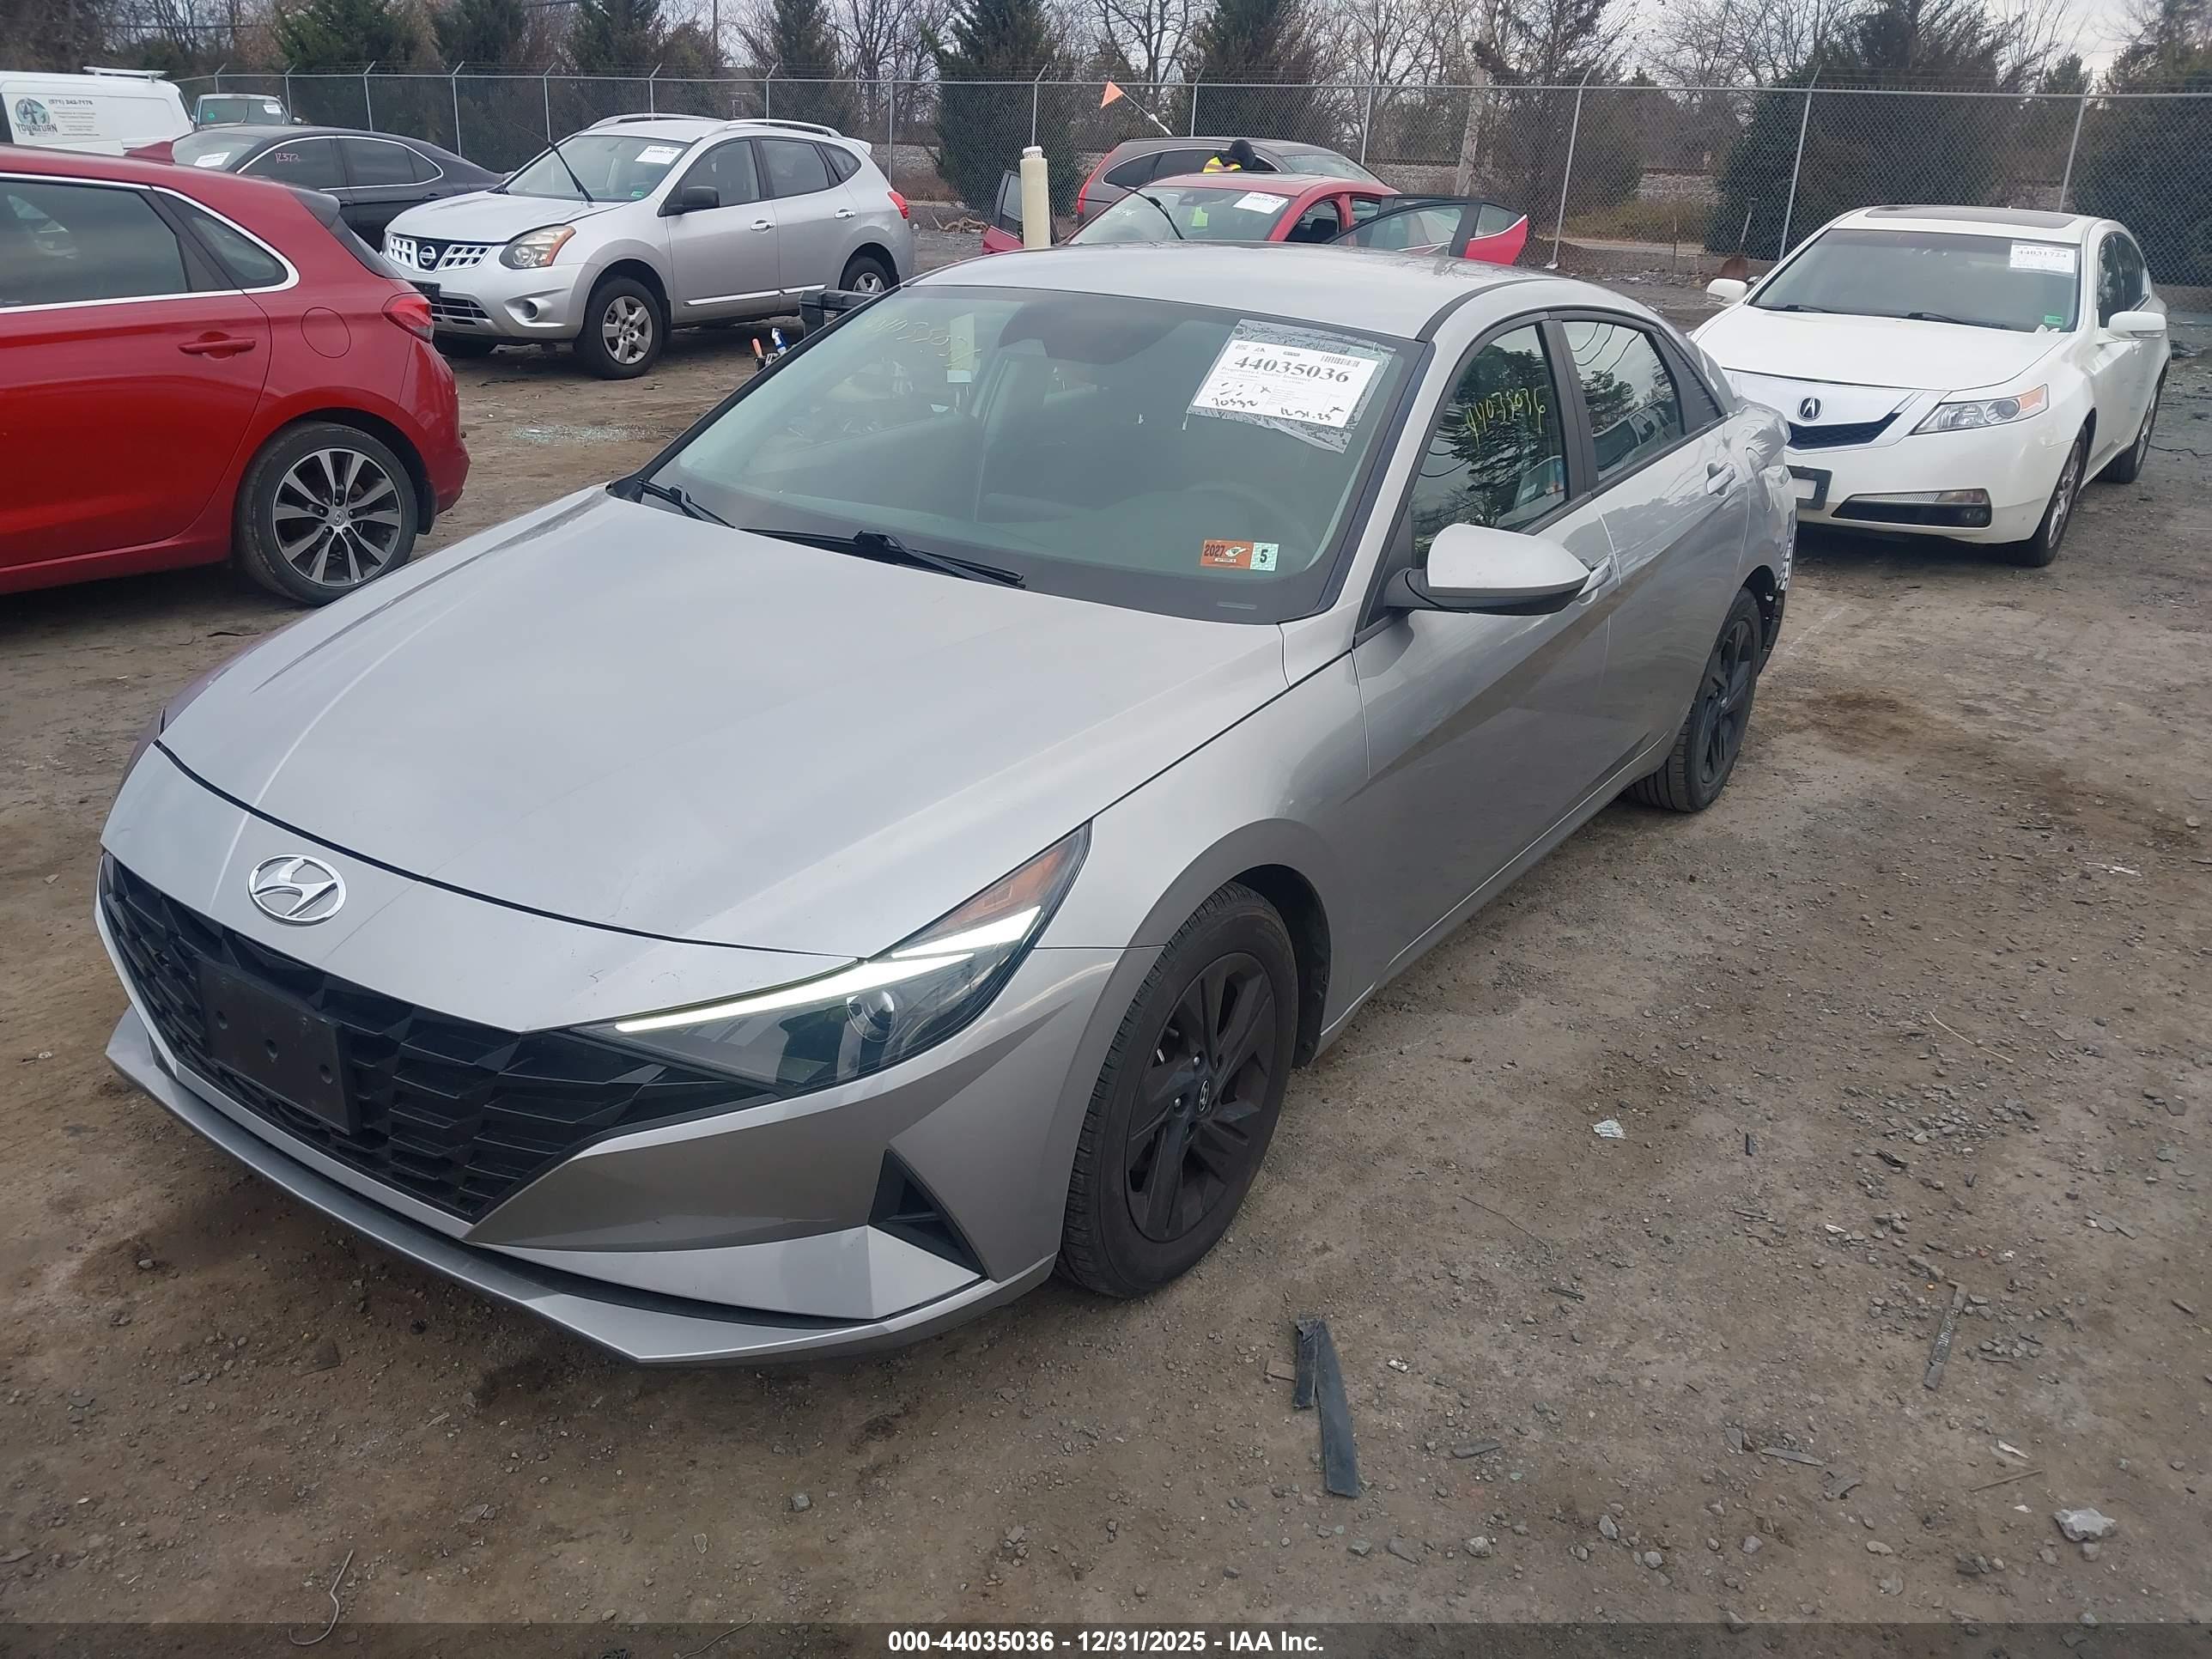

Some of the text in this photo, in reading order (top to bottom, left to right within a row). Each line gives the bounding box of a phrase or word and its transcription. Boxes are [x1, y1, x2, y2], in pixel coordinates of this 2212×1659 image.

[1234, 356, 1352, 384] 44035036
[1204, 544, 1225, 557] 2027
[1259, 549, 1268, 563] 5
